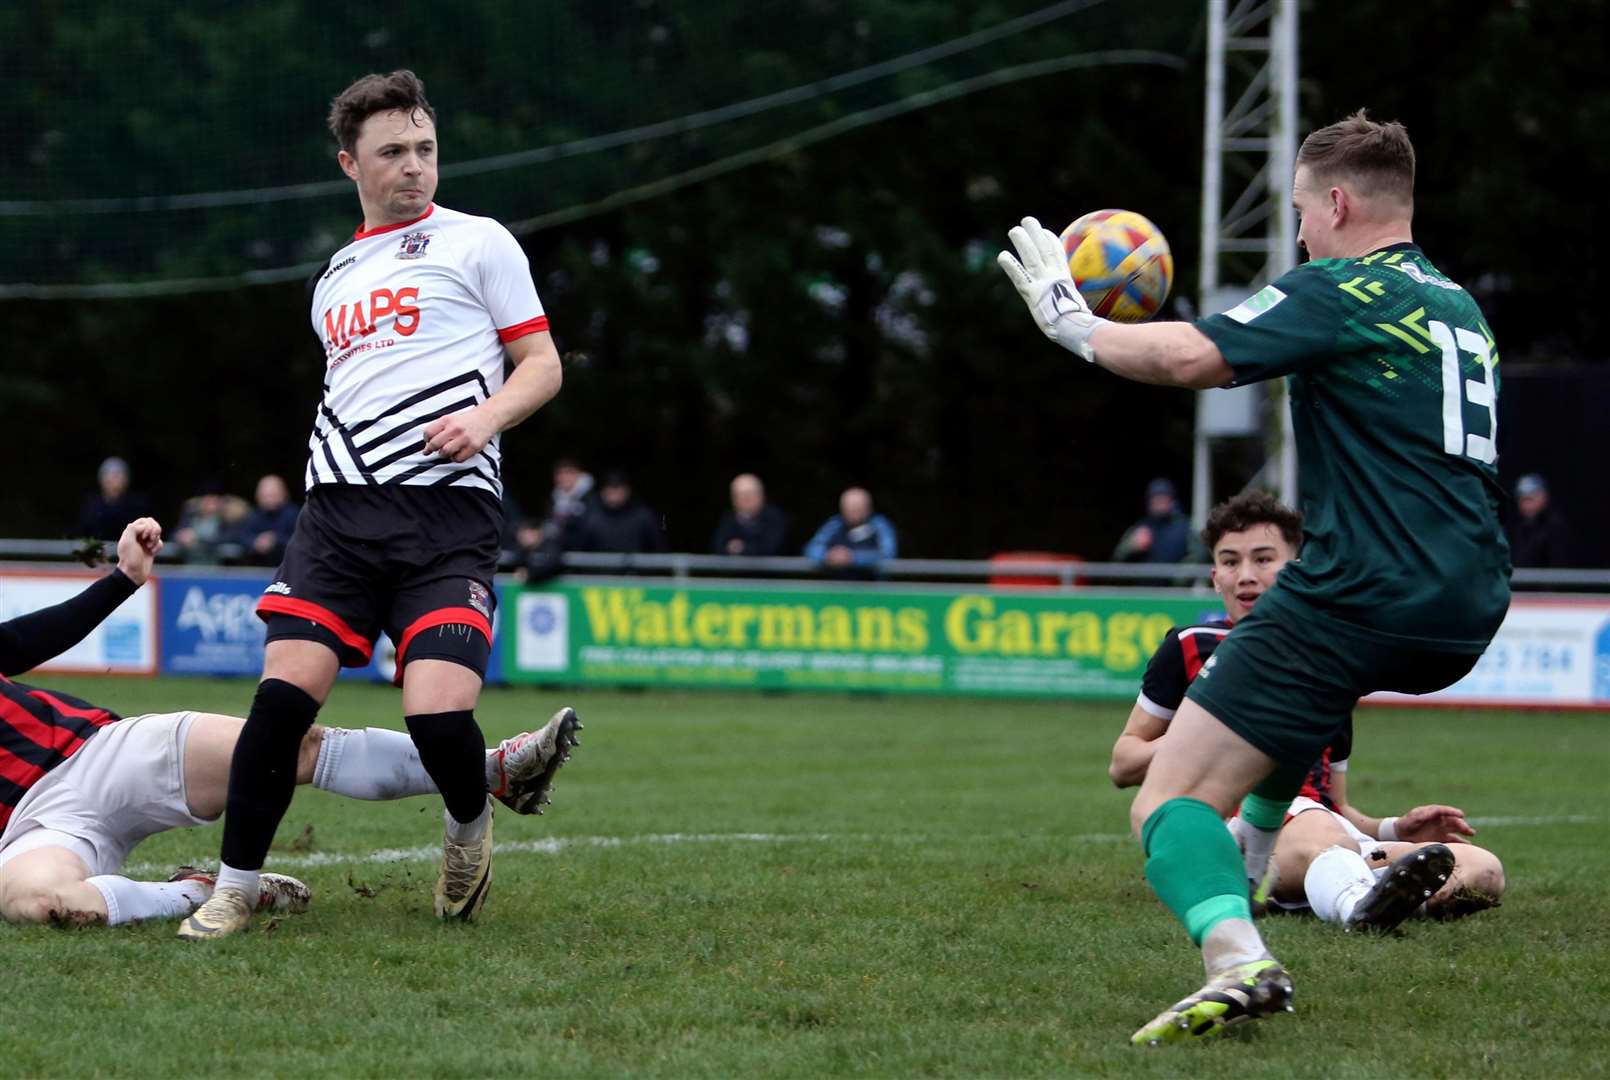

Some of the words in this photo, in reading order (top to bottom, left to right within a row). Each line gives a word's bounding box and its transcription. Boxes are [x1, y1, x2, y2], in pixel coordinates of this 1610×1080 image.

[324, 287, 420, 354] MAPS
[375, 339, 395, 349] LTD
[1428, 320, 1499, 465] 13
[580, 586, 929, 651] Watermans
[944, 594, 1176, 671] Garage
